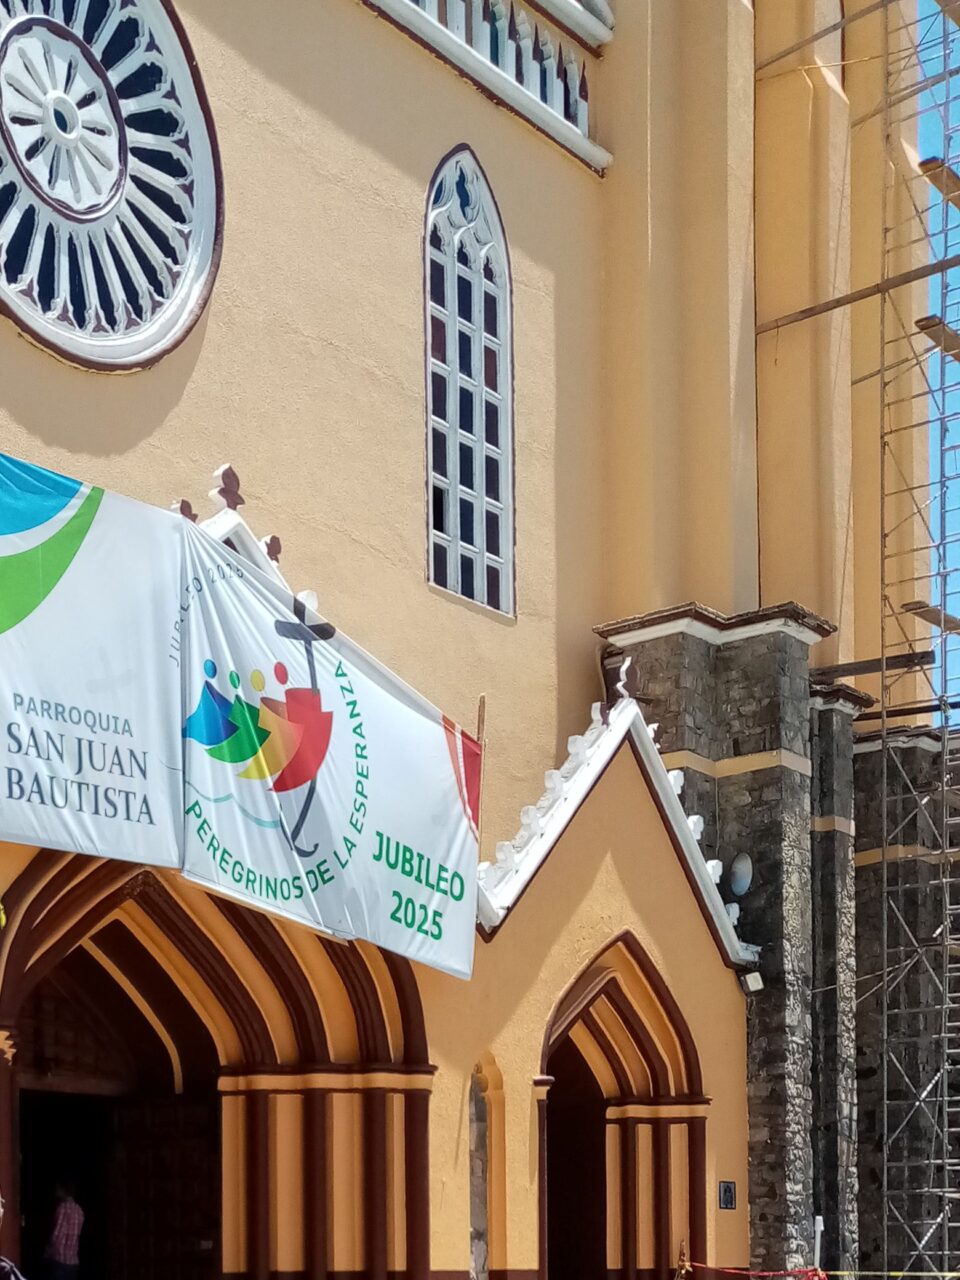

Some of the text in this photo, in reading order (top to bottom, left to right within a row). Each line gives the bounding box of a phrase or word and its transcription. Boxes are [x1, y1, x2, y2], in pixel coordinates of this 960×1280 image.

[13, 693, 133, 737] PARROQUIA
[7, 722, 148, 780] SAN JUAN
[185, 661, 369, 900] PEREGRINOS DE LA ESPERANZA
[5, 766, 156, 826] BAUTISTA
[373, 831, 465, 901] JUBILEO
[390, 891, 443, 941] 2025
